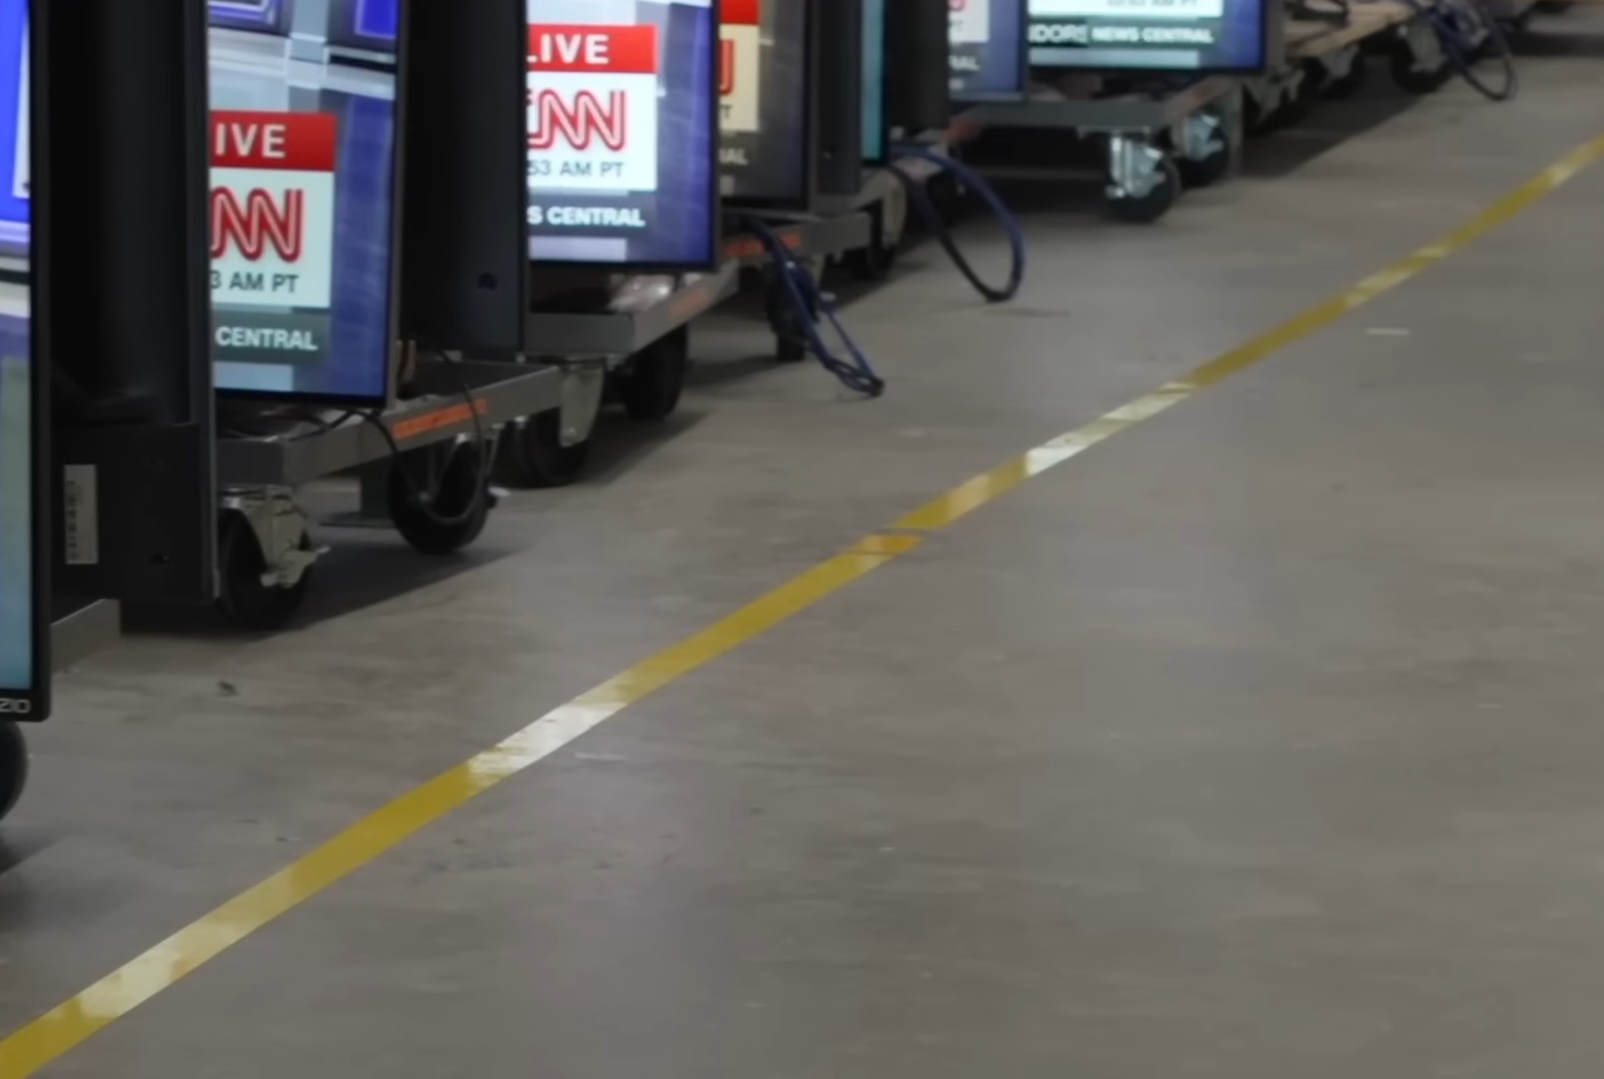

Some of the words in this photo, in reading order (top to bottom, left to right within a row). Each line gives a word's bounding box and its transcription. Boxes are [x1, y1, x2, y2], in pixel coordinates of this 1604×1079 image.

[526, 33, 609, 64] IVE
[215, 124, 286, 158] IVE
[559, 161, 592, 177] AM
[600, 162, 624, 178] PT
[547, 206, 646, 227] CENTRAL
[229, 272, 264, 291] AM
[272, 274, 299, 293] PT
[215, 326, 318, 351] CENTRAL
